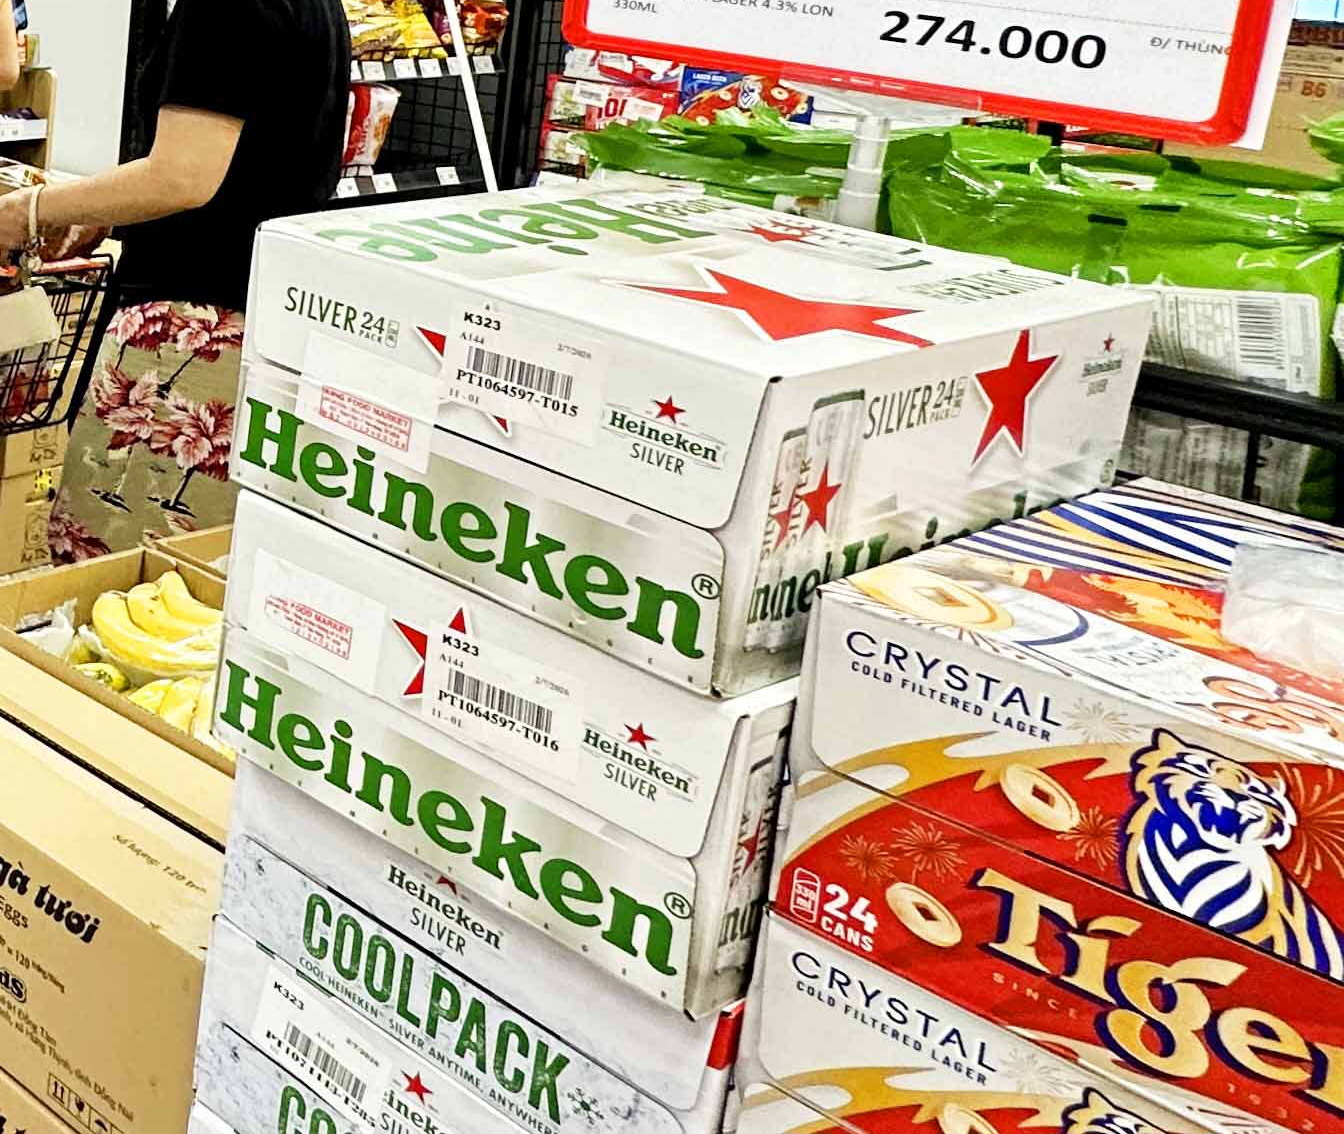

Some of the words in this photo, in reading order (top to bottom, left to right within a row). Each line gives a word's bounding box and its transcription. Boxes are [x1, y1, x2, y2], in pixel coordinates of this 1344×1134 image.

[801, 3, 834, 17] LON
[878, 10, 1108, 69] 274.000
[284, 286, 356, 335] SILVER
[359, 311, 385, 335] 24
[464, 311, 502, 331] K323
[358, 330, 383, 346] PACK
[456, 368, 579, 417] PT1064597-T015
[864, 384, 931, 440] SILVER
[933, 380, 954, 408] 24
[608, 409, 718, 463] Heineken
[630, 441, 685, 476] SILVER
[240, 396, 704, 660] Heineken
[443, 634, 480, 656] K323
[845, 630, 1063, 728] CRYSTAL
[851, 660, 894, 685] COLD
[901, 676, 984, 716] FILTERED
[992, 712, 1052, 743] LAGER
[438, 689, 559, 751] PT1064597-T016
[583, 727, 691, 794] Heineken
[604, 762, 657, 803] SILVER
[220, 659, 677, 976] Heineken
[34, 883, 101, 944] tươi
[387, 865, 502, 949] Heineken
[410, 906, 467, 956] SILVER
[823, 882, 879, 933] 24
[821, 916, 876, 953] CANS
[274, 981, 305, 1011] K323
[302, 892, 571, 1126] COOLPACK
[790, 950, 998, 1073] CRYSTAL
[992, 971, 1080, 1021] SINCE
[388, 1019, 425, 1050] SILVER
[796, 982, 835, 1008] COLD
[843, 1004, 923, 1053] FILTERED
[930, 1049, 987, 1086] LAGER
